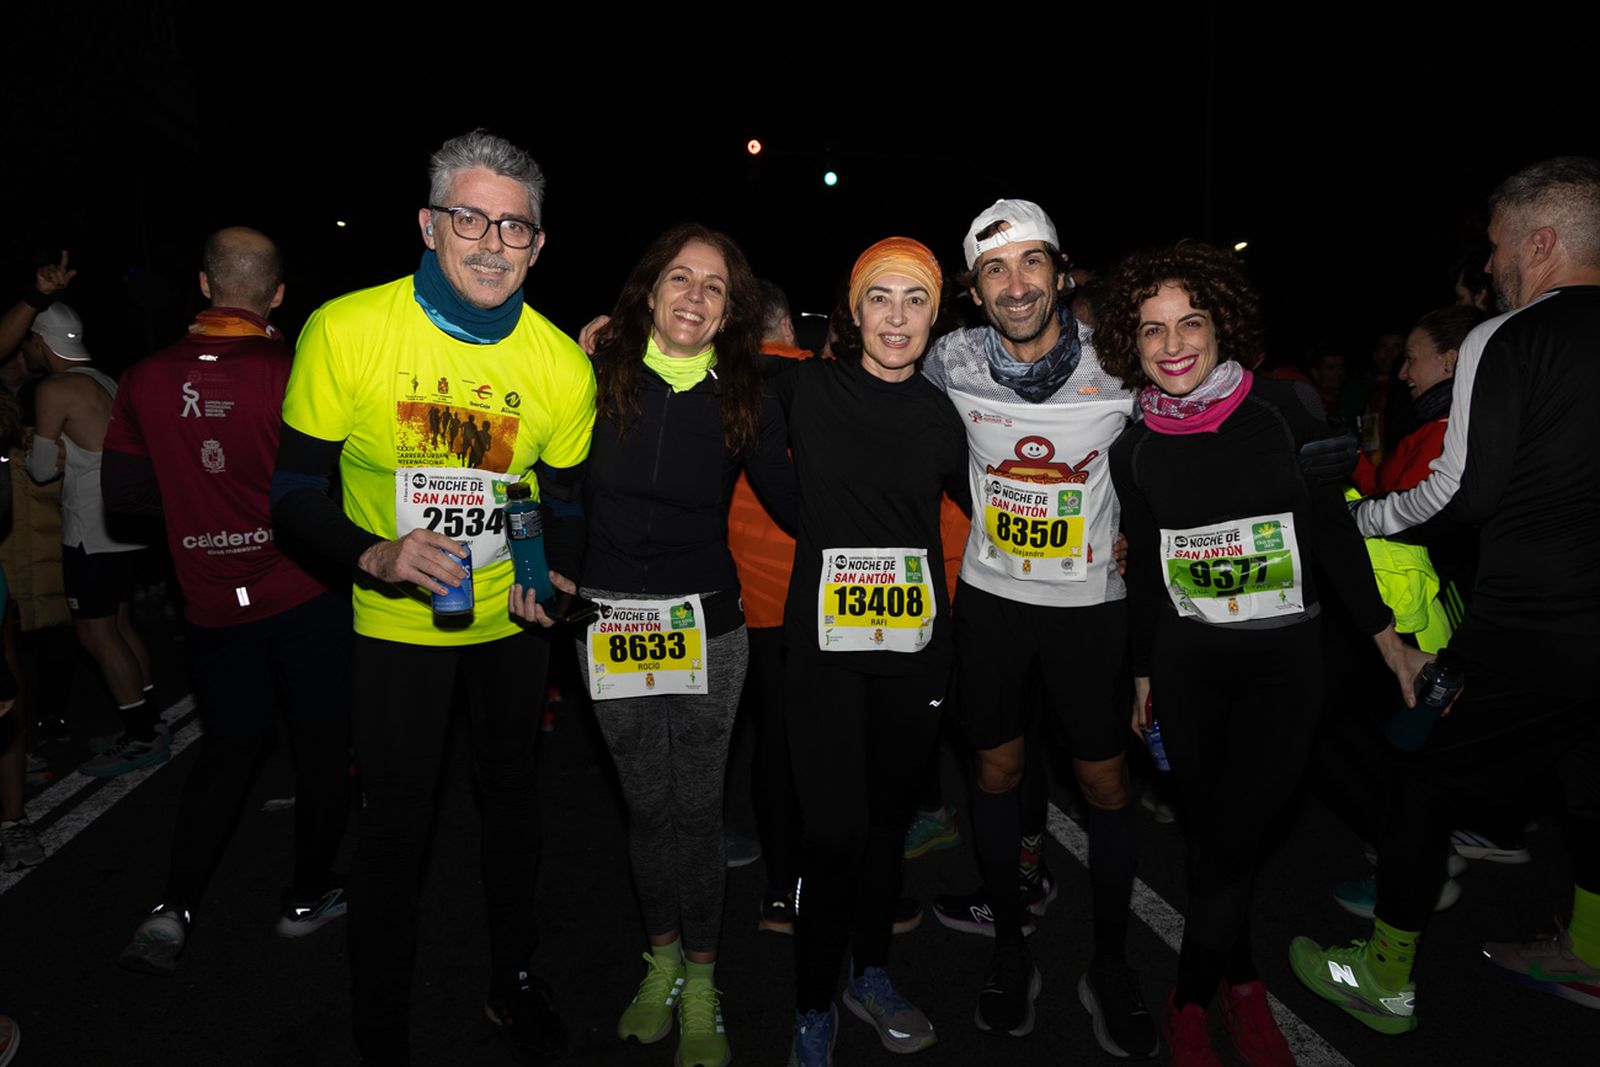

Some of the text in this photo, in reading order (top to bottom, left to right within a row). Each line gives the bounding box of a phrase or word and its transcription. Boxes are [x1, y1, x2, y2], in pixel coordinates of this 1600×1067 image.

[413, 476, 426, 486] 43
[429, 480, 484, 492] NOCHE DE
[412, 492, 484, 506] SAN ANTÓN
[1002, 488, 1033, 504] NOCHE
[1035, 495, 1048, 505] DE
[991, 496, 1010, 511] SAN
[1010, 502, 1048, 518] ANTÓN
[423, 507, 504, 538] 2534
[997, 511, 1068, 548] 8350
[1190, 534, 1224, 548] NOCHE
[1226, 531, 1240, 543] DE
[1012, 547, 1045, 558] Alejandro
[1174, 543, 1243, 560] SAN ANTÓN
[835, 556, 847, 567] 43
[848, 560, 896, 571] NOCHE DE
[833, 573, 856, 583] SAN
[858, 571, 895, 584] ANTÓN
[1189, 556, 1267, 589] 9377
[834, 585, 923, 617] 13408
[612, 610, 660, 621] NOCHE DE
[871, 618, 887, 626] RAFI
[600, 622, 621, 633] SAN
[623, 621, 661, 633] ANTÓN
[609, 632, 686, 663] 8633
[638, 661, 660, 670] ROCÍO
[1328, 960, 1359, 988] N
